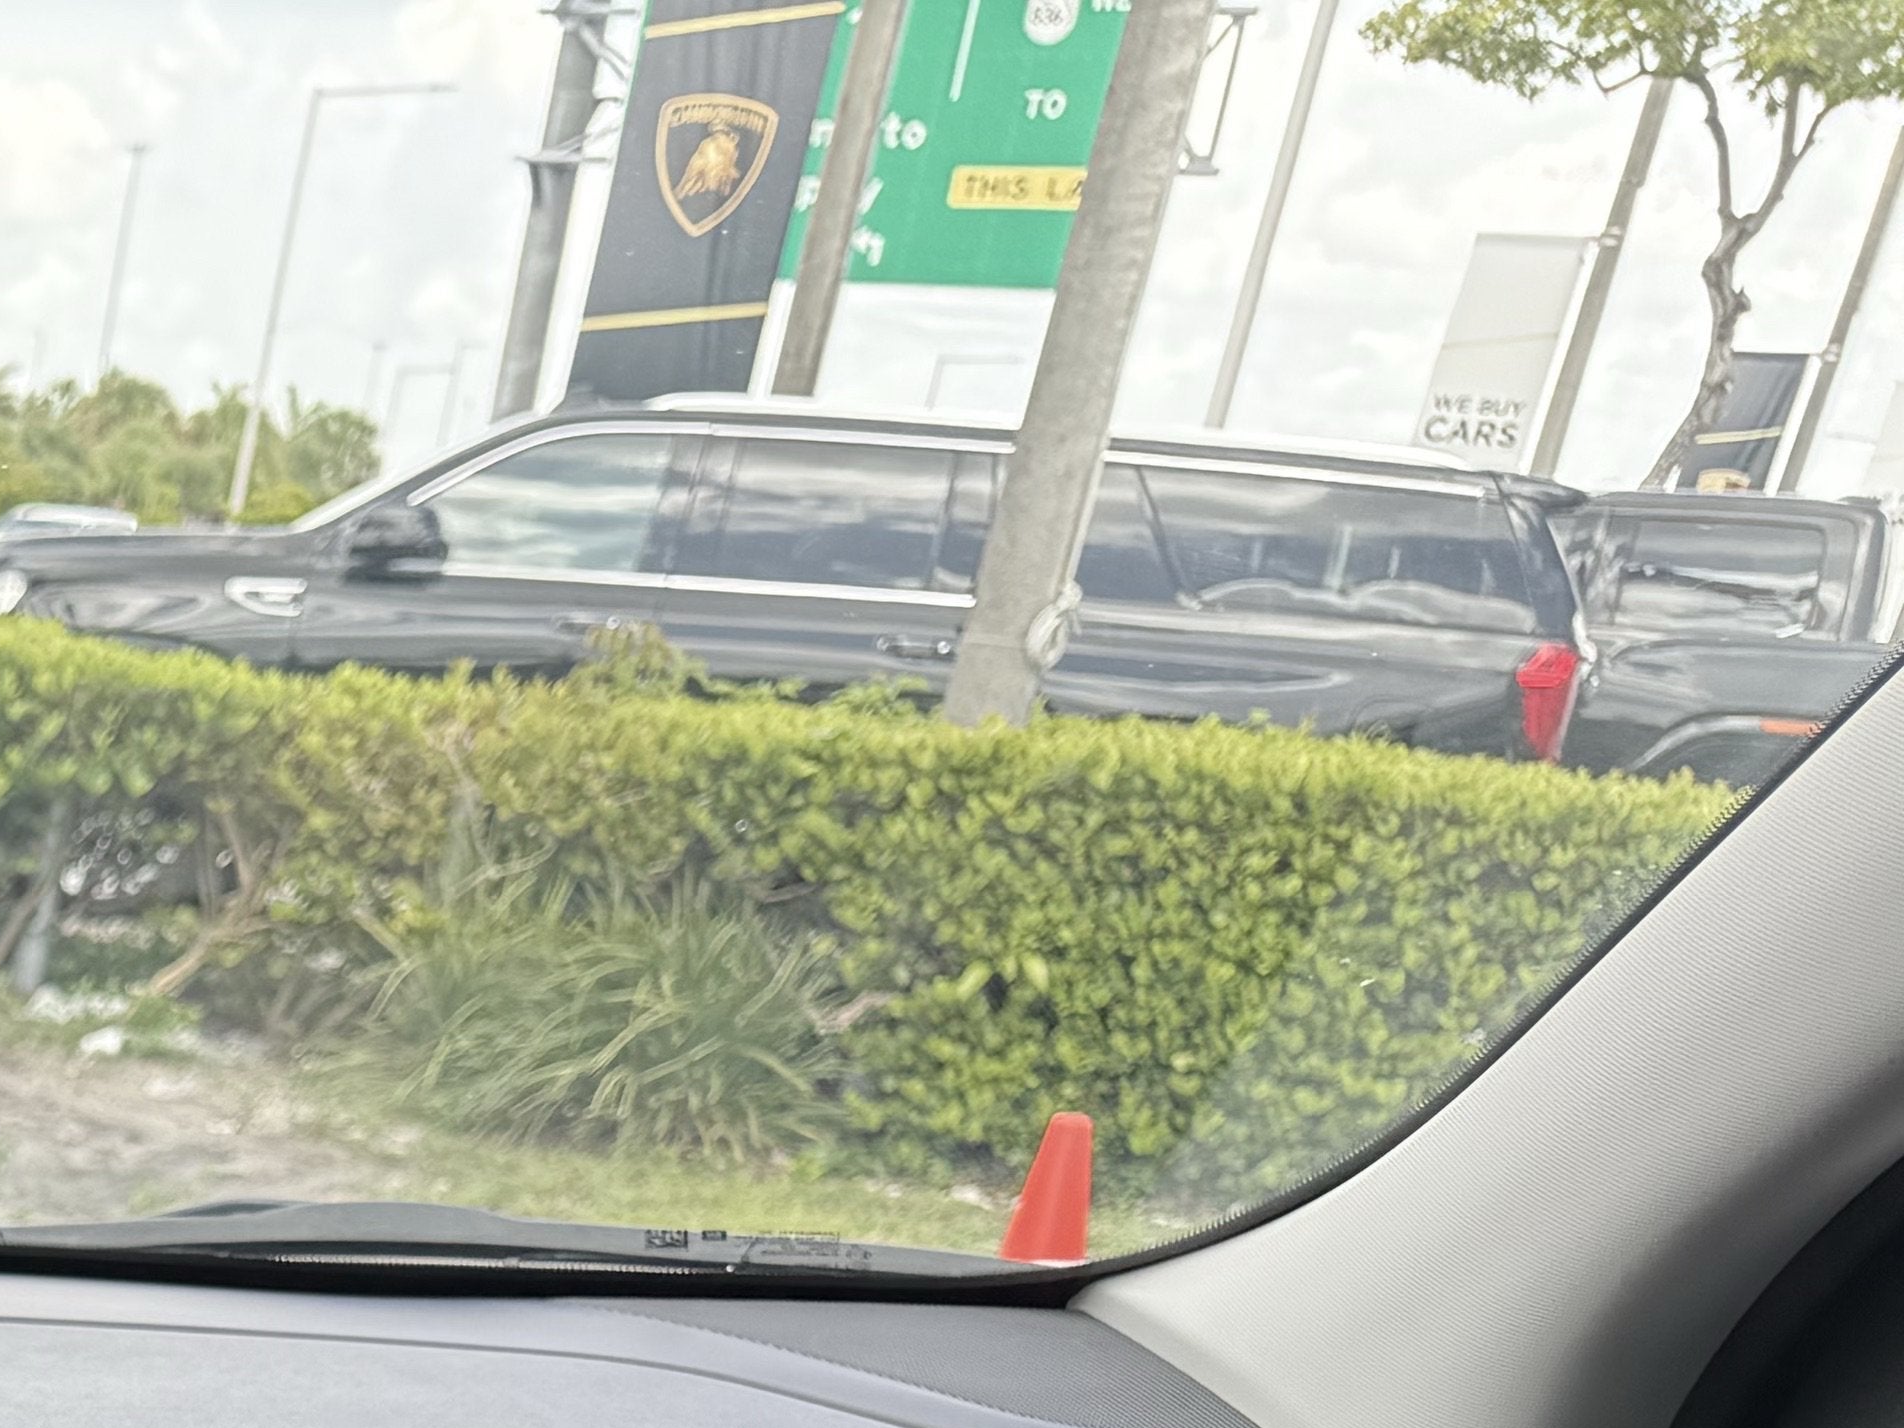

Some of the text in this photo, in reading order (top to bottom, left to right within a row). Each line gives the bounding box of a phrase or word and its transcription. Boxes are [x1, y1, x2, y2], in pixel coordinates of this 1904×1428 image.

[1024, 88, 1068, 120] TO
[965, 174, 1030, 201] THIS
[1433, 394, 1527, 418] WE BUY
[1424, 415, 1518, 448] CARS
